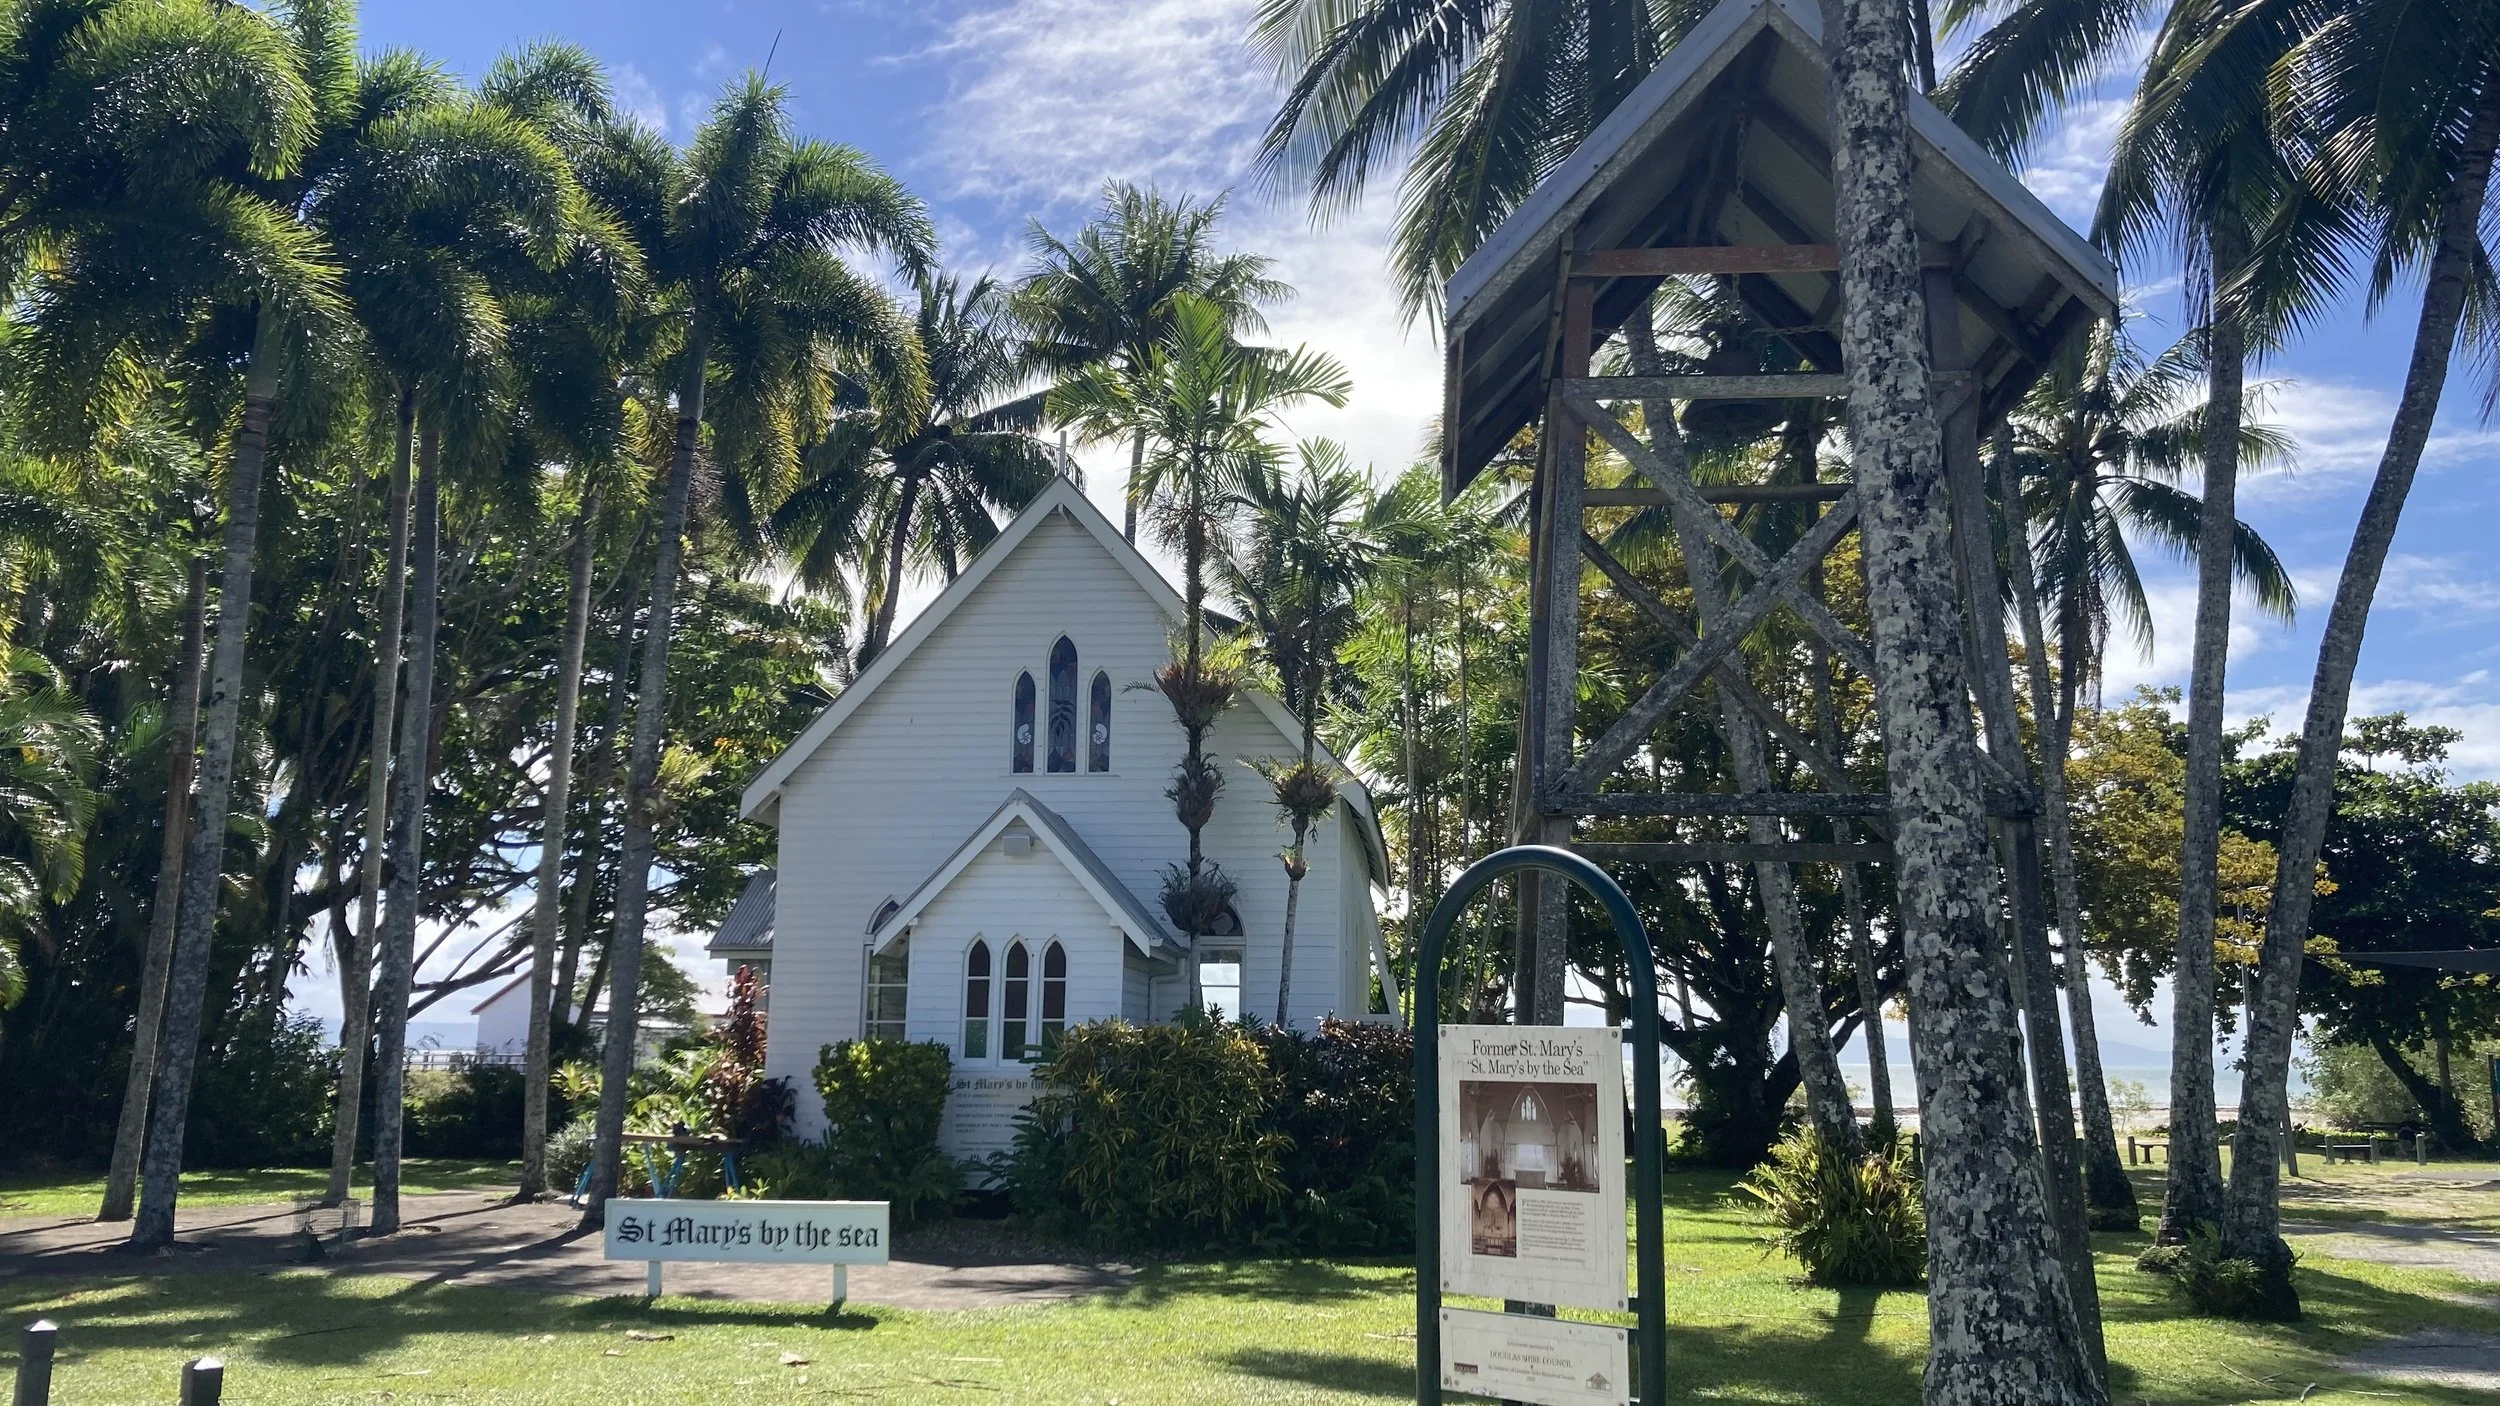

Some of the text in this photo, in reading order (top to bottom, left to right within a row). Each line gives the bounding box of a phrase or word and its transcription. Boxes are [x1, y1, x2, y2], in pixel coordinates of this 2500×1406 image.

[1472, 1039, 1583, 1060] Former St. Mary's
[1488, 1059, 1525, 1078] Mary's
[1527, 1059, 1540, 1078] by
[1543, 1060, 1561, 1075] the
[956, 1078, 970, 1090] St
[974, 1078, 1012, 1091] Mary's
[1016, 1079, 1027, 1091] by
[617, 1216, 879, 1252] St Mary's by the sea
[1490, 1350, 1521, 1362] DOUGLAS
[1542, 1356, 1573, 1369] COUNCIL
